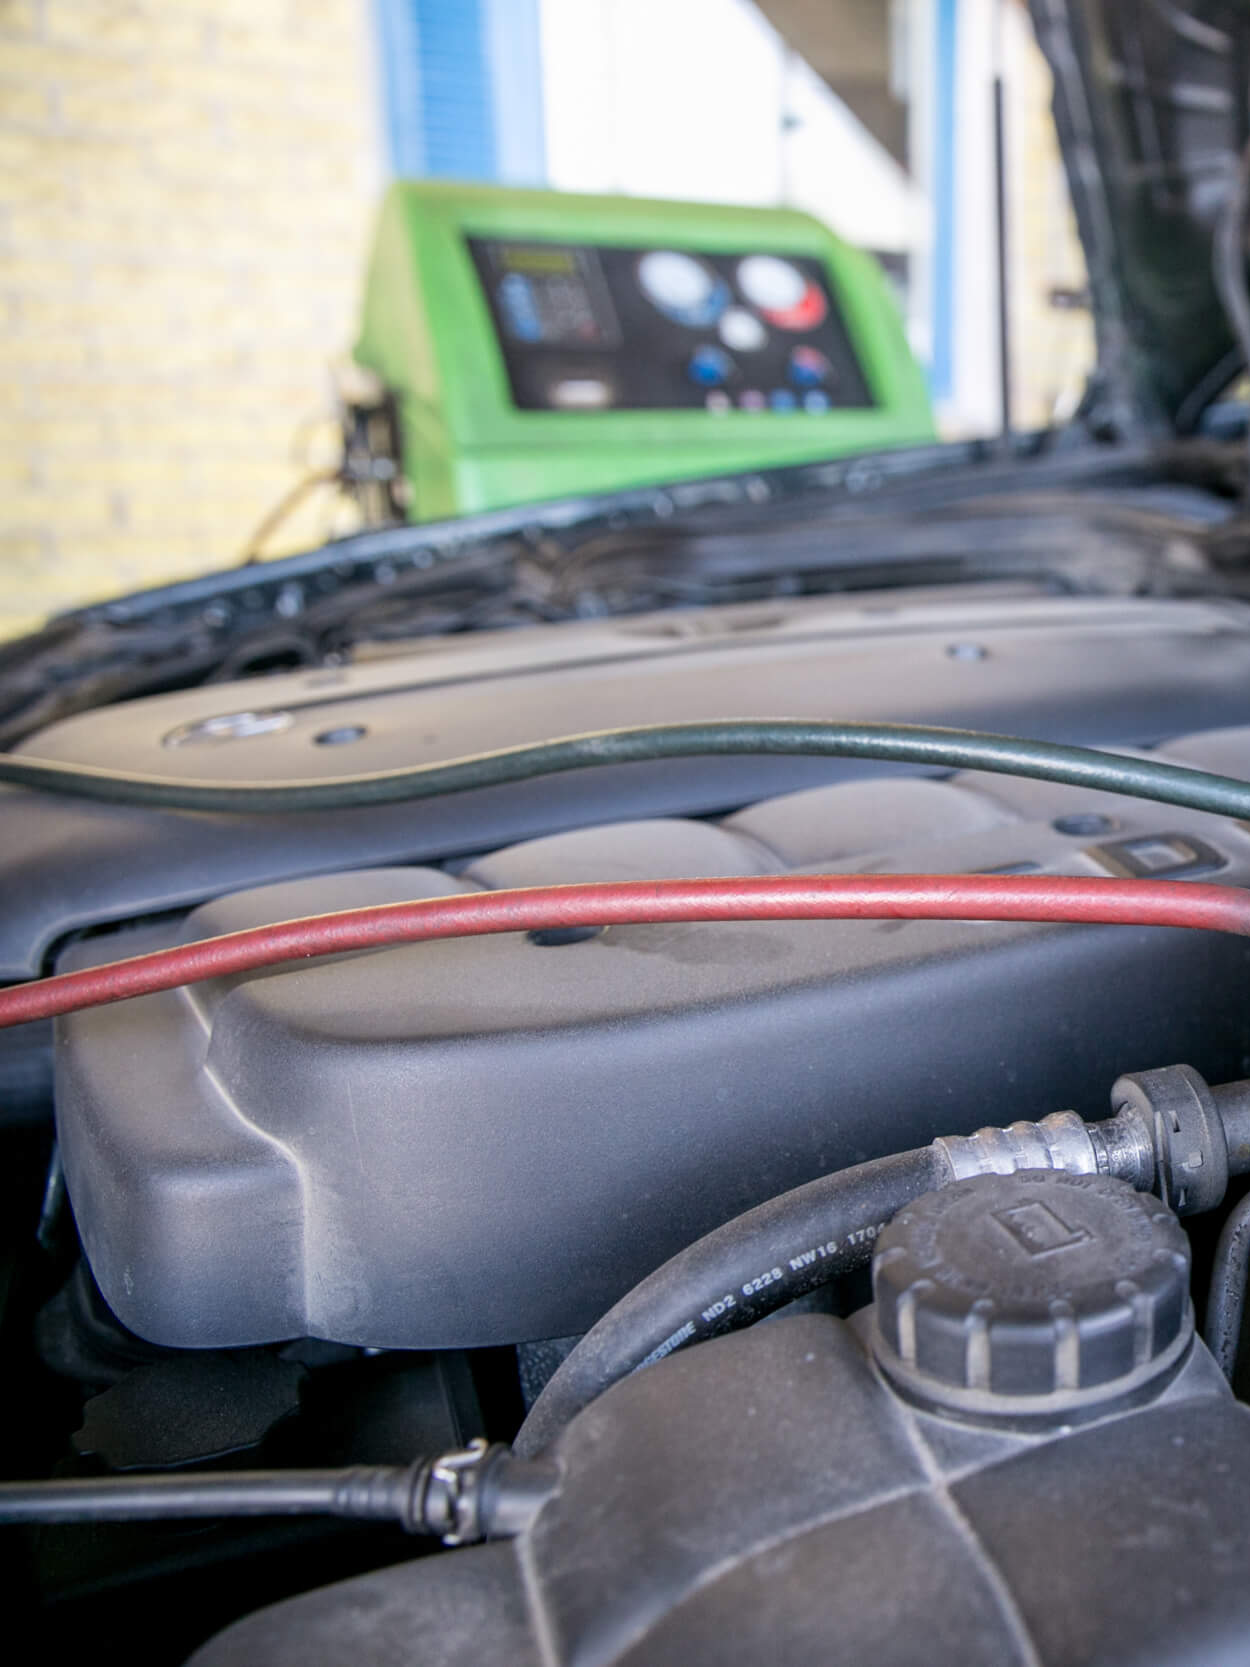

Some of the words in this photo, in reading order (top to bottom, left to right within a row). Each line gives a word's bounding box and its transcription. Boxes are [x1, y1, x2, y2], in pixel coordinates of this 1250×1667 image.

[702, 1294, 737, 1323] ND2
[742, 1267, 783, 1297] 6228
[789, 1241, 838, 1271] NW16
